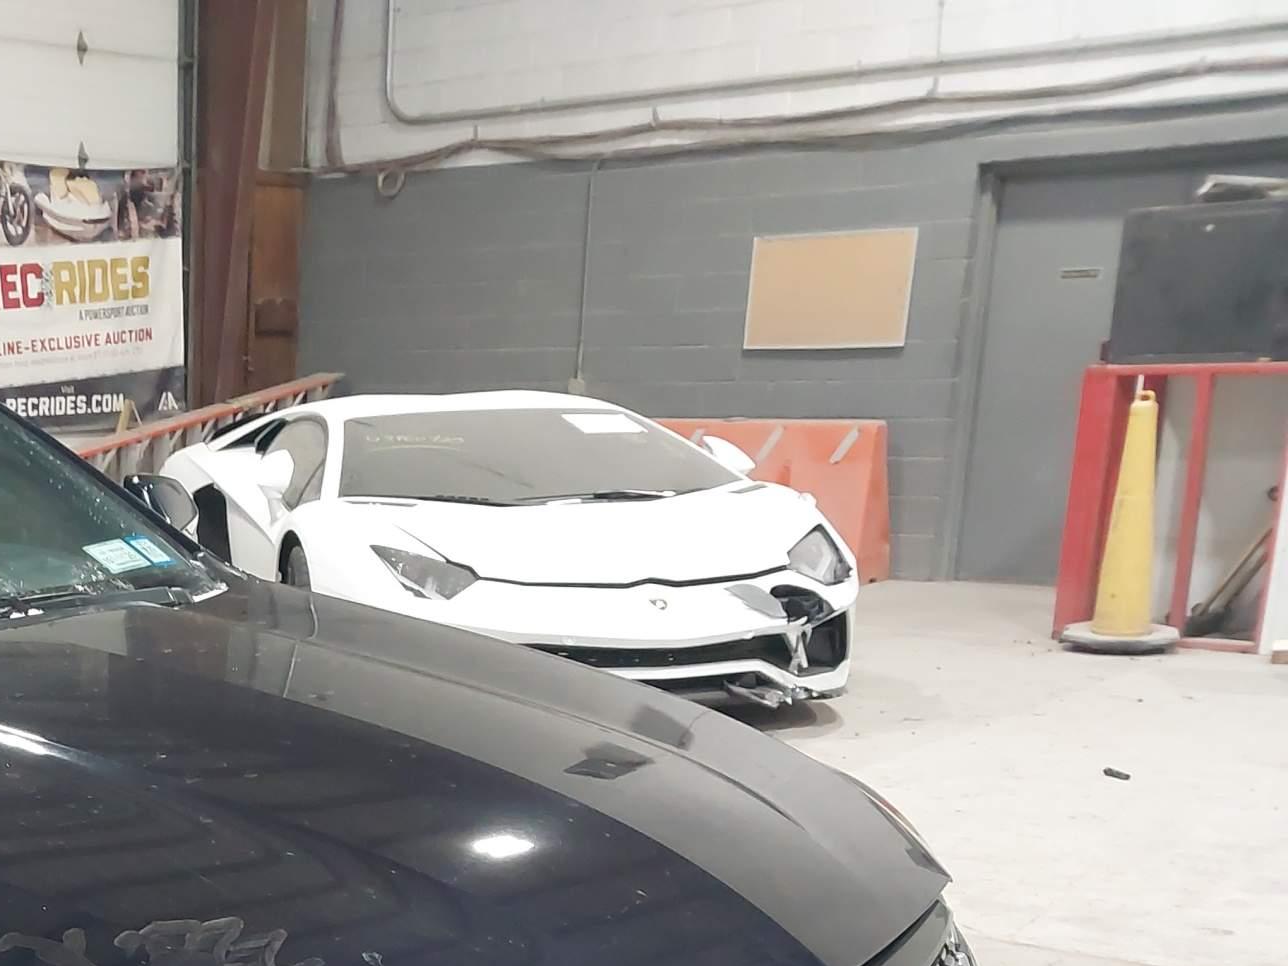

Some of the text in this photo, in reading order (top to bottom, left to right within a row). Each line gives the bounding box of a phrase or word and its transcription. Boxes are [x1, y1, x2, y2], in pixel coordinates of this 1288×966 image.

[52, 255, 150, 306] RIDES
[125, 304, 149, 317] AUCTION
[105, 327, 153, 345] AUCTION
